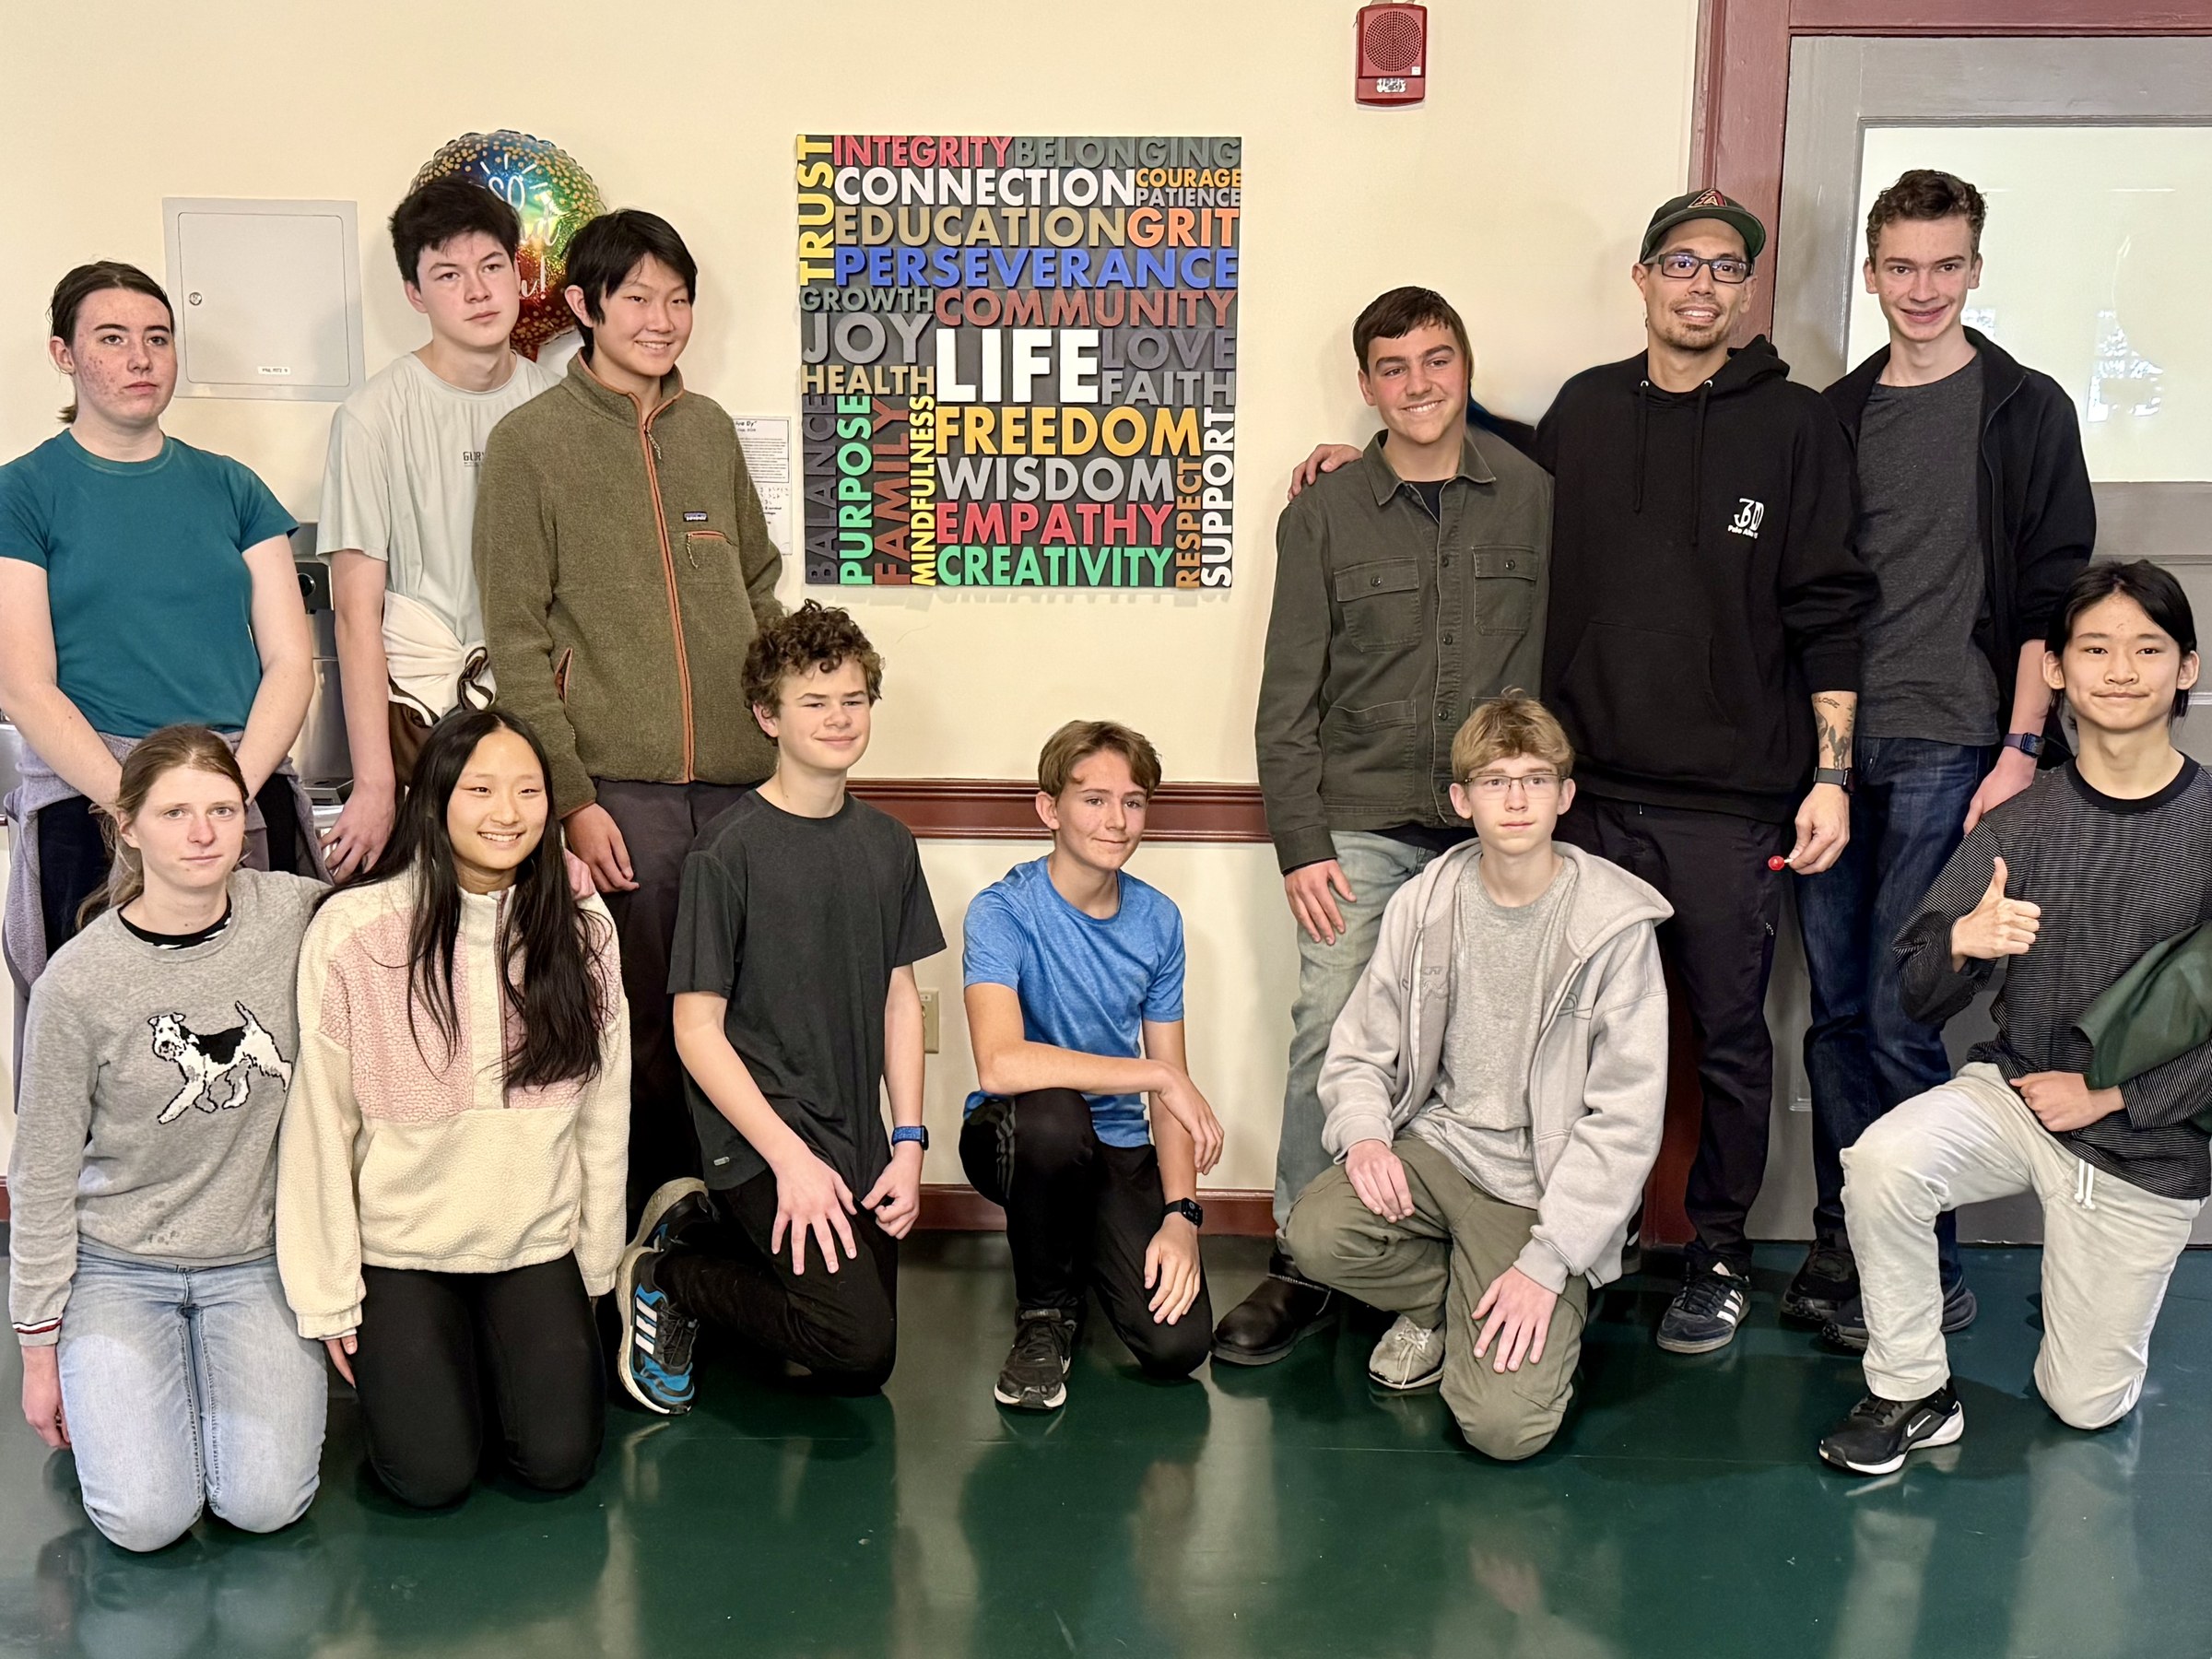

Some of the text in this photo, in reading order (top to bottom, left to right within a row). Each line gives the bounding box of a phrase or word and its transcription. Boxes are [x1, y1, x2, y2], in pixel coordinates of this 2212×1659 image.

[834, 136, 1014, 167] INTEGRITY
[1015, 137, 1241, 169] BELONGING
[834, 168, 1135, 206] CONNECTION
[1135, 168, 1241, 187] COURAGE
[1135, 188, 1241, 206] PATIENCE
[798, 135, 835, 286] TRUST
[835, 206, 1125, 246] EDUCATION
[1127, 206, 1240, 247] GRIT
[836, 248, 1239, 288] PERSEVERANCE
[800, 287, 935, 312] GROWTH
[935, 288, 1237, 326] COMMUNITY
[803, 312, 935, 364] JOY
[1102, 329, 1236, 370] LOVE
[800, 365, 935, 394] HEALTH
[935, 328, 1100, 403] LIFE
[1103, 371, 1236, 406] FAITH
[935, 406, 1202, 457] FREEDOM
[803, 394, 839, 583] BALANCE
[837, 394, 874, 584] PURPOSE
[872, 396, 911, 586] FAMILY
[909, 394, 936, 586] MINDFULNESS
[936, 457, 1175, 502] WISDOM
[1202, 406, 1235, 588] SUPPORT
[935, 503, 1174, 546] EMPATHY
[1175, 457, 1203, 589] RESPECT
[936, 546, 1175, 587] CREATIVITY
